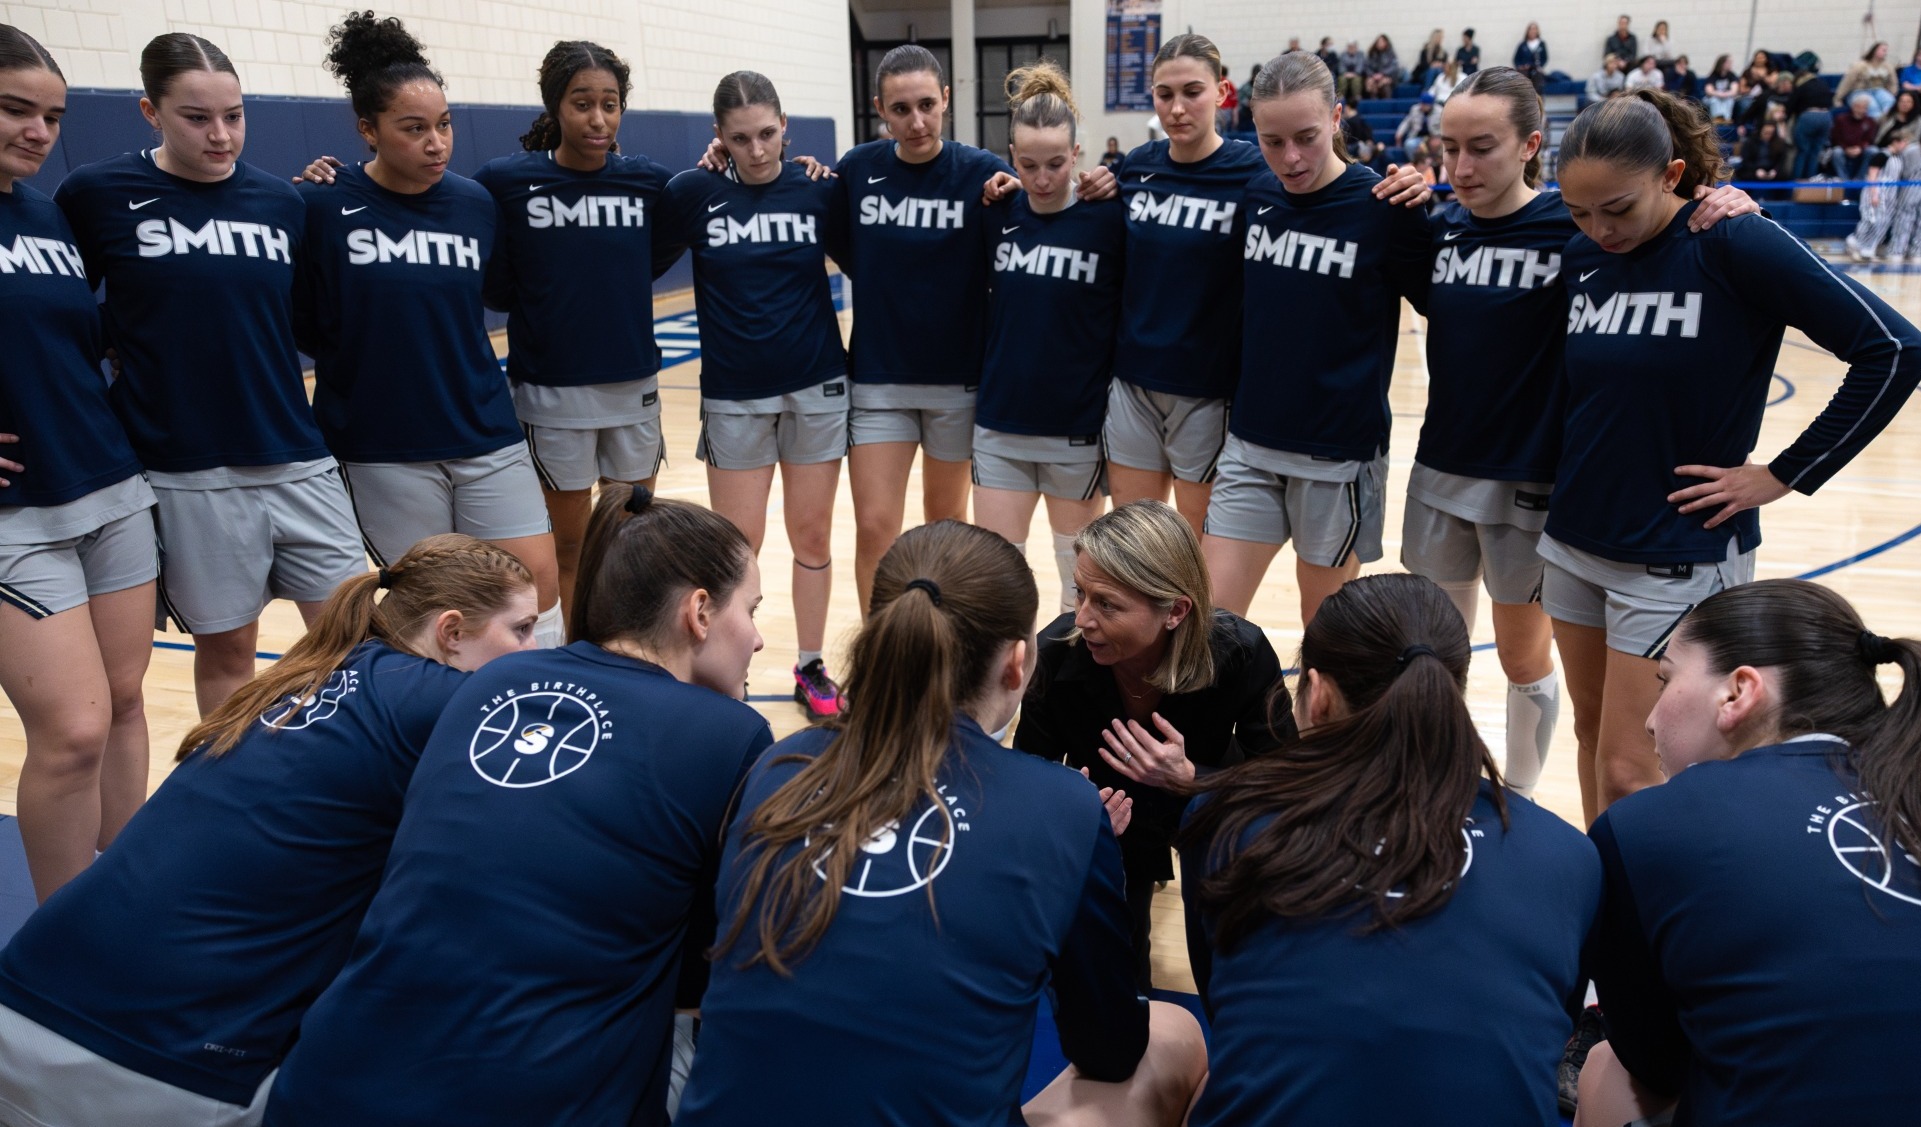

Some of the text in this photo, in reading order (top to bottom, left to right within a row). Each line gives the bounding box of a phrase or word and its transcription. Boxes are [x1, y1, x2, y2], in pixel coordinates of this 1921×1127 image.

[526, 194, 644, 229] SMITH
[706, 212, 817, 248] SMITH
[859, 194, 965, 229] SMITH
[1129, 191, 1237, 234] SMITH
[0, 233, 87, 279] MITH
[135, 216, 291, 265] SMITH
[346, 227, 481, 271] SMITH
[1243, 223, 1359, 279] SMITH
[994, 241, 1099, 284] SMITH
[1431, 245, 1562, 289] SMITH
[1567, 291, 1703, 338] SMITH
[1678, 564, 1687, 573] M
[480, 681, 613, 740] THE BIRTHPLACE
[513, 722, 555, 755] S
[1807, 805, 1832, 834] THE
